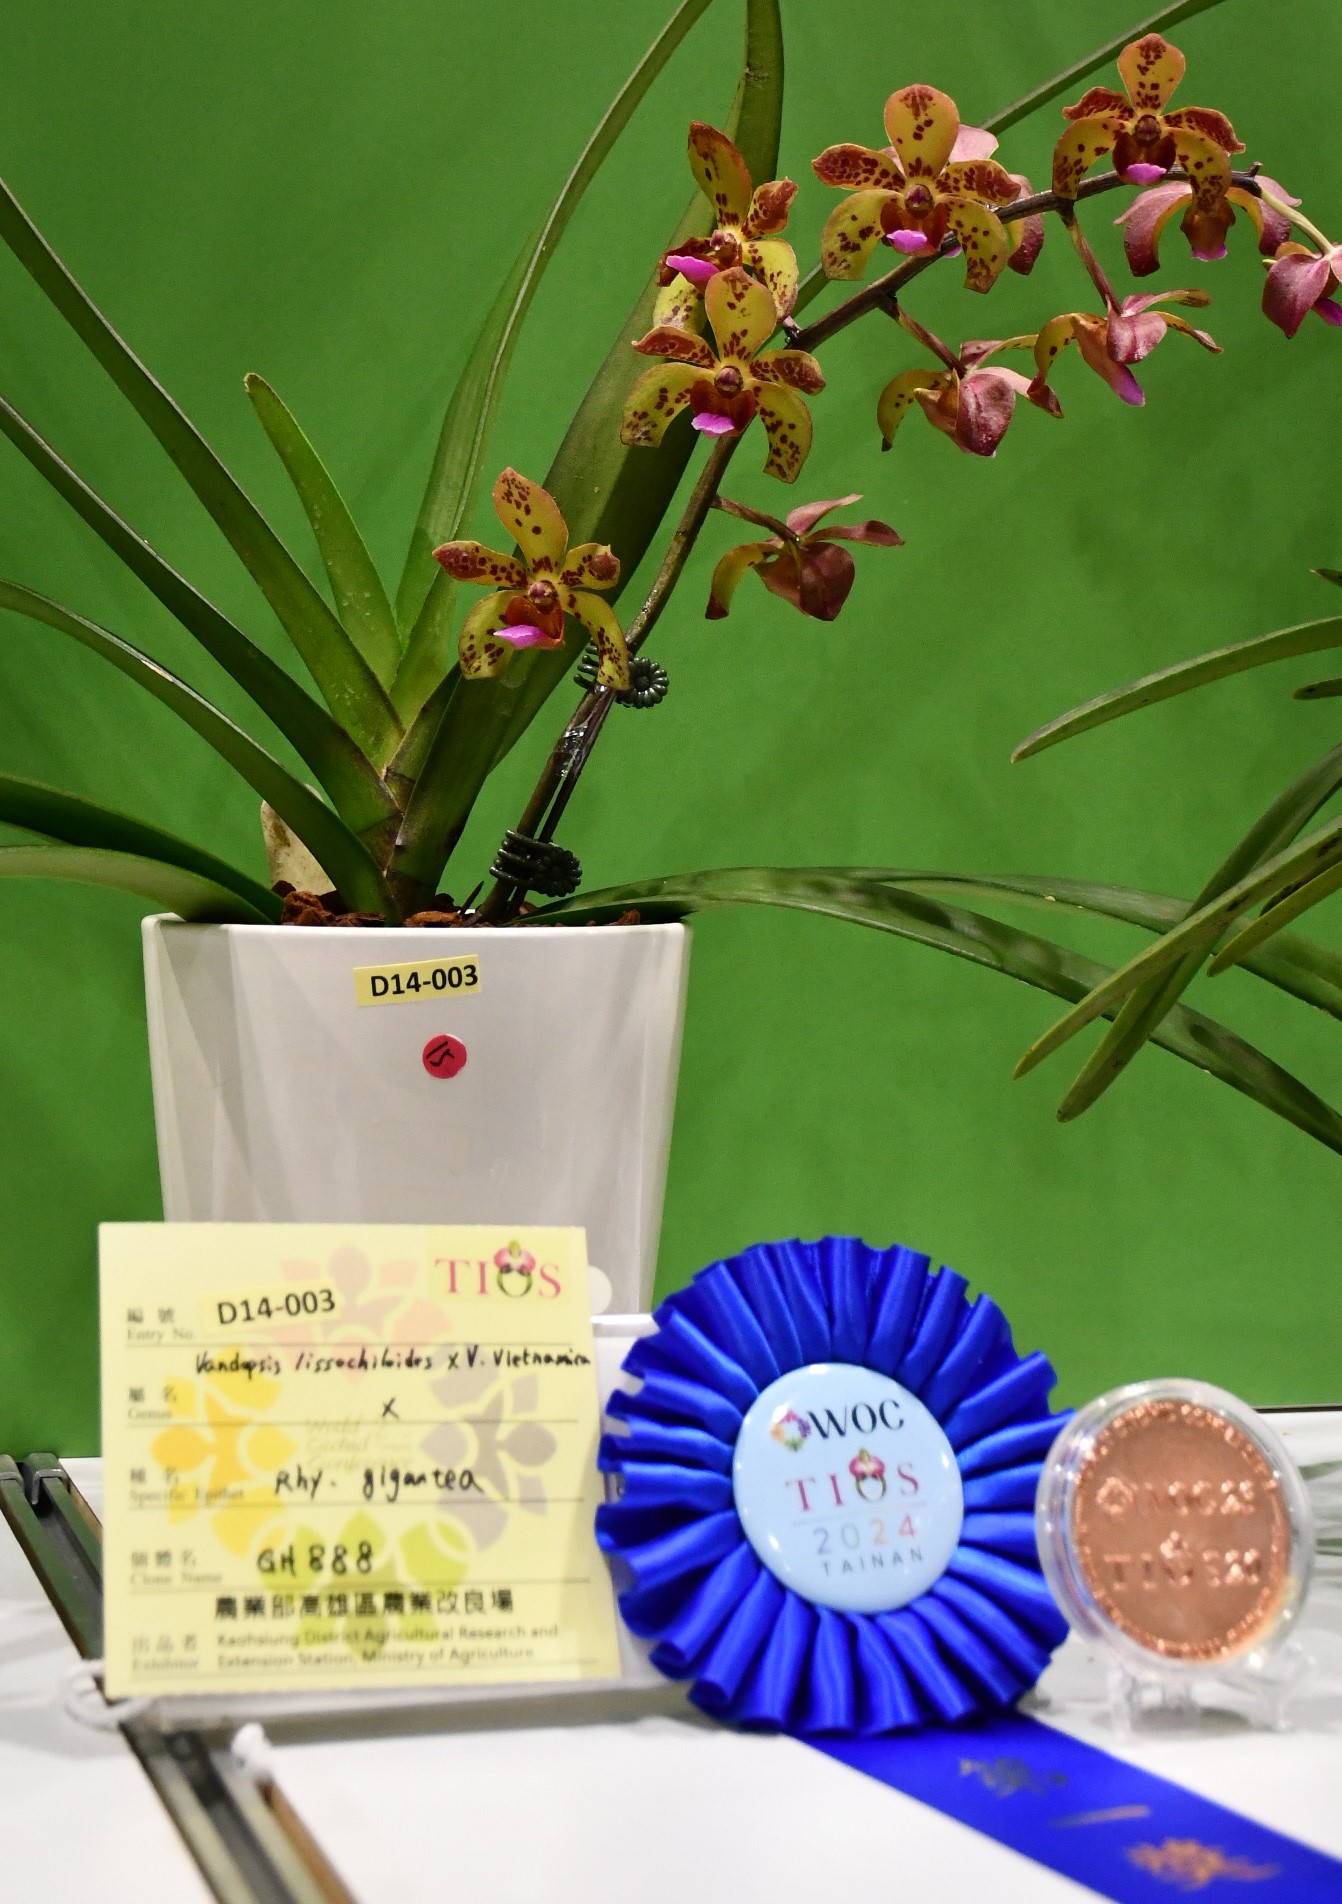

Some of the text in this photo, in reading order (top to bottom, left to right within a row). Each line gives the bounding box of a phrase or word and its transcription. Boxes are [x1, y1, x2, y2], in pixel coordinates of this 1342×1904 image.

[370, 964, 479, 997] D14-003
[434, 1257, 562, 1299] TIOS
[217, 1289, 336, 1326] D14-003
[806, 1399, 905, 1441] WOC
[362, 1465, 485, 1502] gigantea
[784, 1460, 920, 1513] TIOS
[812, 1513, 916, 1556] 2024
[308, 1540, 374, 1575] 888
[820, 1547, 925, 1576] TAINAN
[217, 1623, 559, 1650] Kaohsiung District Agricultural Research and
[217, 1654, 294, 1669] Extension
[361, 1648, 424, 1668] Ministry
[429, 1647, 444, 1661] of
[450, 1645, 535, 1666] Agriculture
